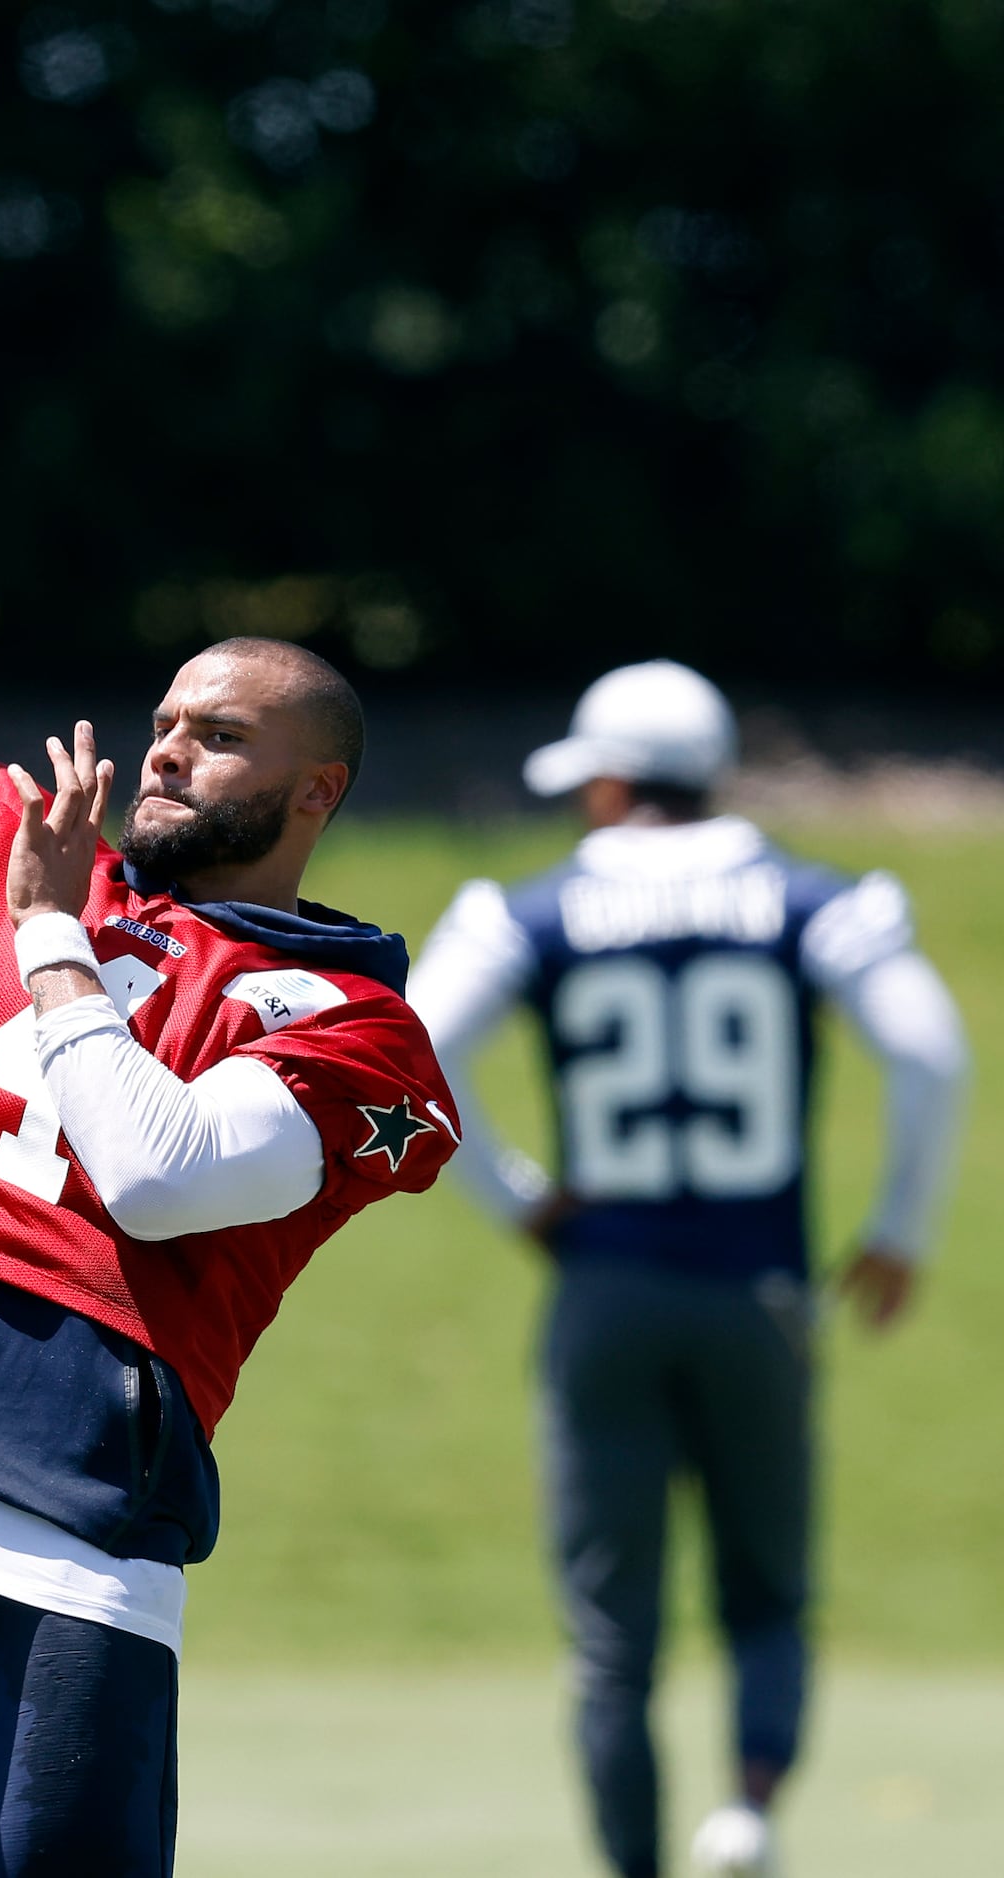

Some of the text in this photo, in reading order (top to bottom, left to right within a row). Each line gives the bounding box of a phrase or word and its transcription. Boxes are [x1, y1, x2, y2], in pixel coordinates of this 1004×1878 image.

[104, 916, 187, 958] COWBOYS
[244, 985, 291, 1019] AT&T
[555, 955, 798, 1200] 29
